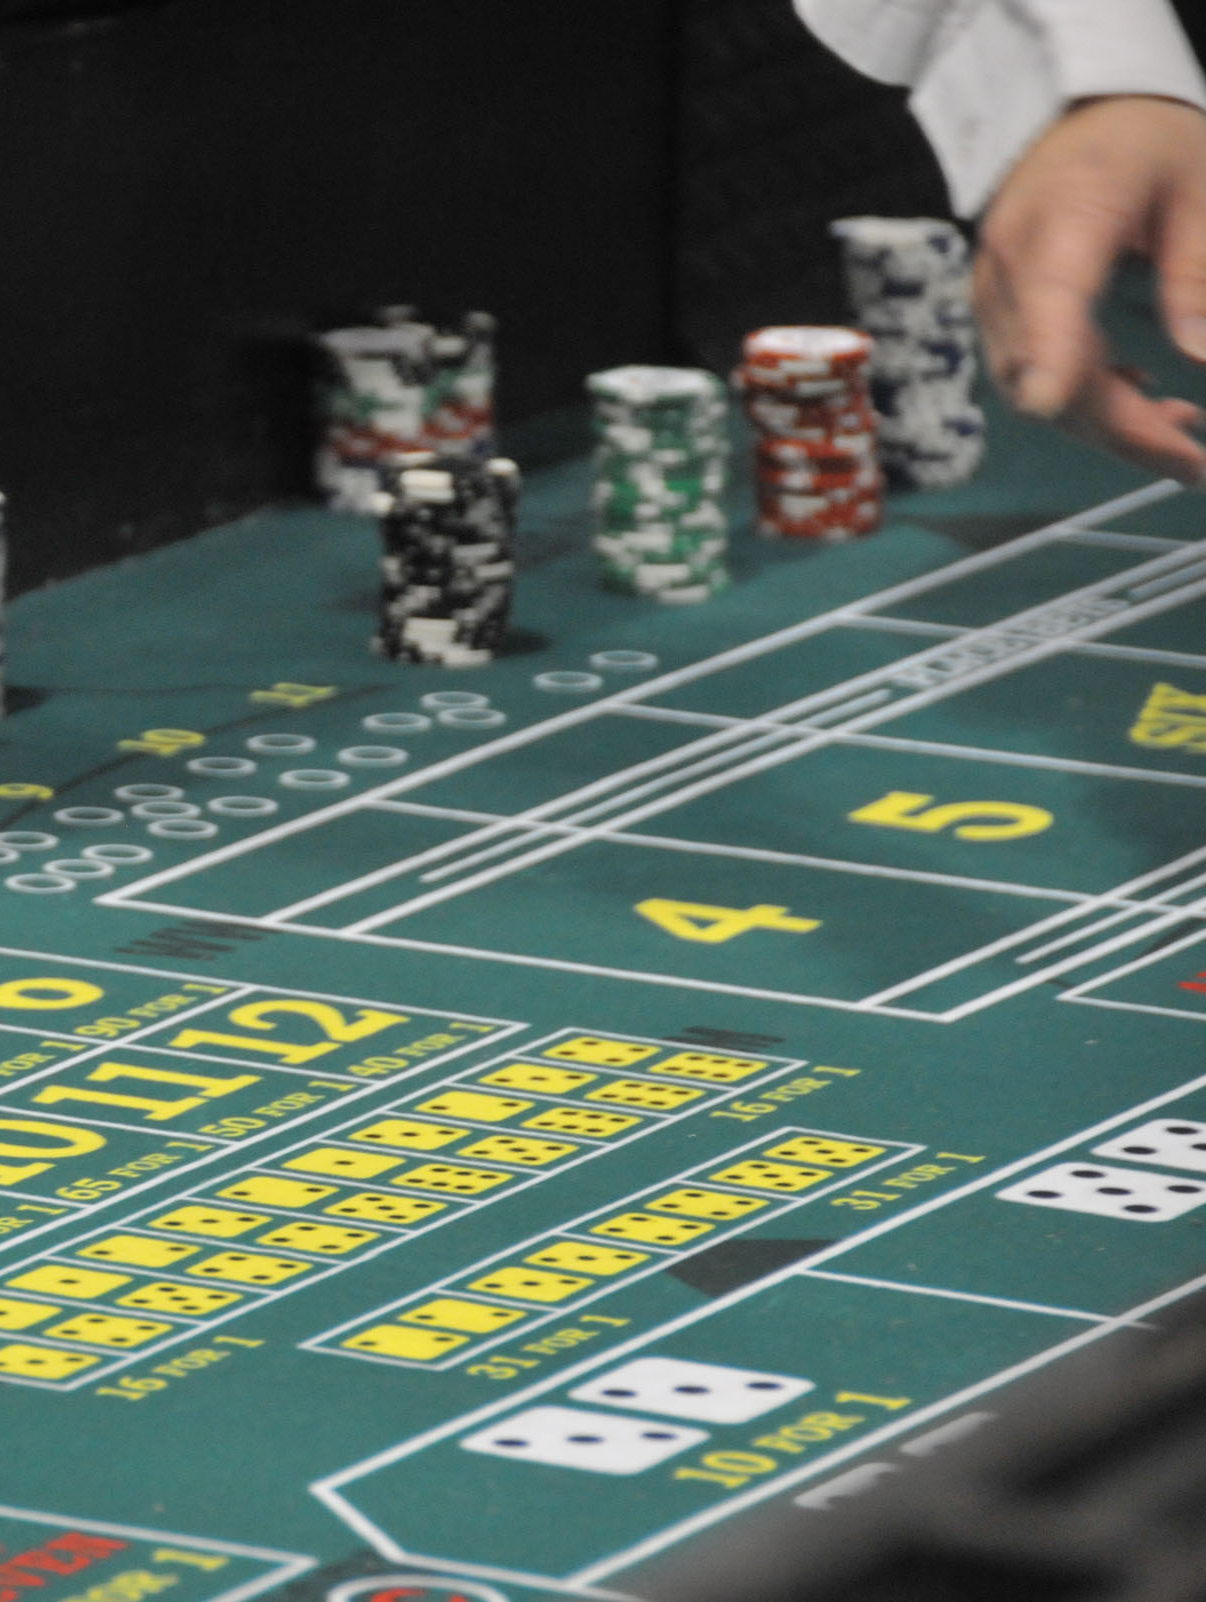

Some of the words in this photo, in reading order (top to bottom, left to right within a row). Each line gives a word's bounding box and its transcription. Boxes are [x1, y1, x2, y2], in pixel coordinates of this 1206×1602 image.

[117, 728, 206, 757] 10
[846, 790, 1054, 842] 5
[633, 897, 824, 946] 4
[74, 1016, 142, 1038] 90
[129, 994, 196, 1018] FOR
[184, 984, 226, 995] 1
[167, 997, 410, 1065] 12
[42, 1042, 86, 1051] 1
[347, 1056, 410, 1078] 40
[394, 1034, 465, 1057] FOR
[450, 1022, 496, 1033] 1
[31, 1060, 264, 1122] 11
[197, 1116, 267, 1138] 50
[253, 1092, 324, 1117] FOR
[310, 1080, 356, 1091] 1
[709, 1100, 778, 1123] 16
[761, 1077, 831, 1102] FOR
[814, 1066, 859, 1077] 1
[55, 1177, 123, 1202] 65
[109, 1153, 182, 1178] FOR
[167, 1141, 213, 1152] 1
[830, 1189, 903, 1211] 31
[883, 1164, 955, 1189] FOR
[938, 1152, 985, 1163] 1
[19, 1204, 68, 1216] 1
[95, 1375, 169, 1401] 16
[153, 1349, 230, 1377] FOR
[214, 1336, 264, 1347] 1
[465, 1355, 542, 1380] 31
[524, 1328, 598, 1355] FOR
[580, 1315, 630, 1327] 1
[673, 1451, 778, 1489] 10
[752, 1411, 866, 1454] FOR
[836, 1392, 911, 1410] 1
